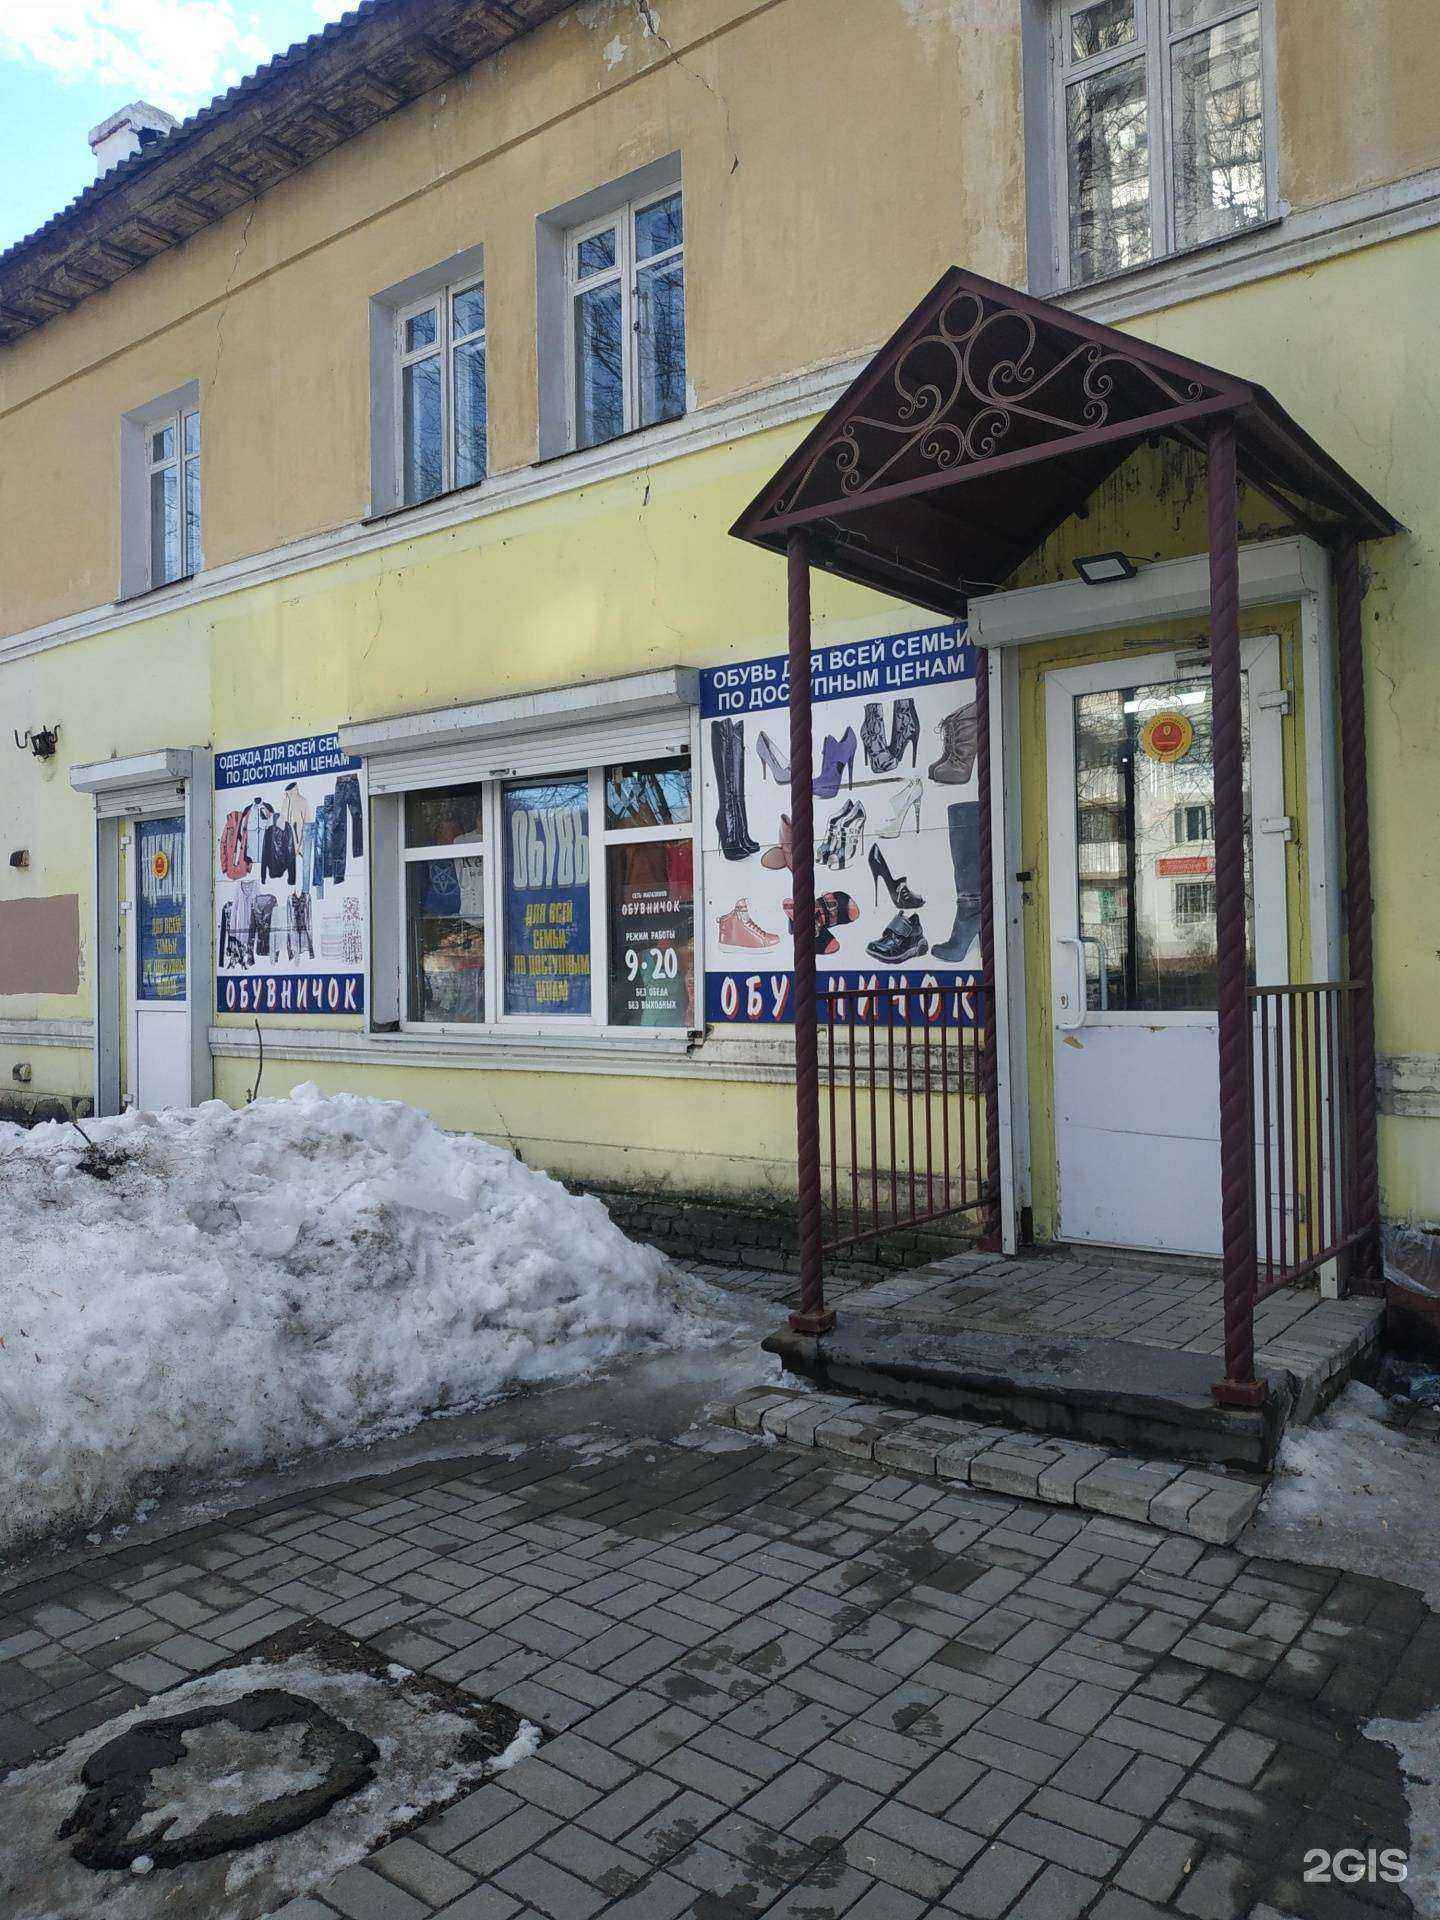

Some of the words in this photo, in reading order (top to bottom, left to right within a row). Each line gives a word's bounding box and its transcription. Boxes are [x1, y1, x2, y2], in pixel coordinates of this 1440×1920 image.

[713, 666, 776, 690] ОБУВЬ
[829, 640, 885, 669] ВСЕЙ
[718, 691, 745, 711] ПО
[749, 668, 879, 710] ДОСПНЫМ
[886, 653, 965, 686] ЦЕНАМ
[219, 752, 261, 770] ОДЕЖДА
[263, 746, 285, 762] ДЛЯ
[288, 738, 316, 757] ВСЕЙ
[226, 770, 240, 784] ПО
[242, 760, 308, 784] ДОСТУПНЫМ
[311, 753, 350, 772] ЦЕНАМ
[511, 807, 590, 889] ОБУВЬ
[525, 903, 545, 926] ДЛЯ
[548, 900, 573, 924] ВСЕЙ
[621, 899, 680, 916] ОБУВНИЧОК
[533, 928, 566, 950] СЕМЬИ
[625, 932, 649, 941] РЕЖИМ
[650, 930, 675, 940] РАБОТЫ
[225, 976, 358, 1011] ОБУВНИЧОК
[628, 1001, 639, 1010] БЕЗ
[641, 1000, 676, 1010] ВЫХОДНЫХ
[635, 987, 647, 997] БЕЗ
[648, 987, 669, 996] ОБЕДА
[720, 974, 977, 1021] ОБУНИЧОК
